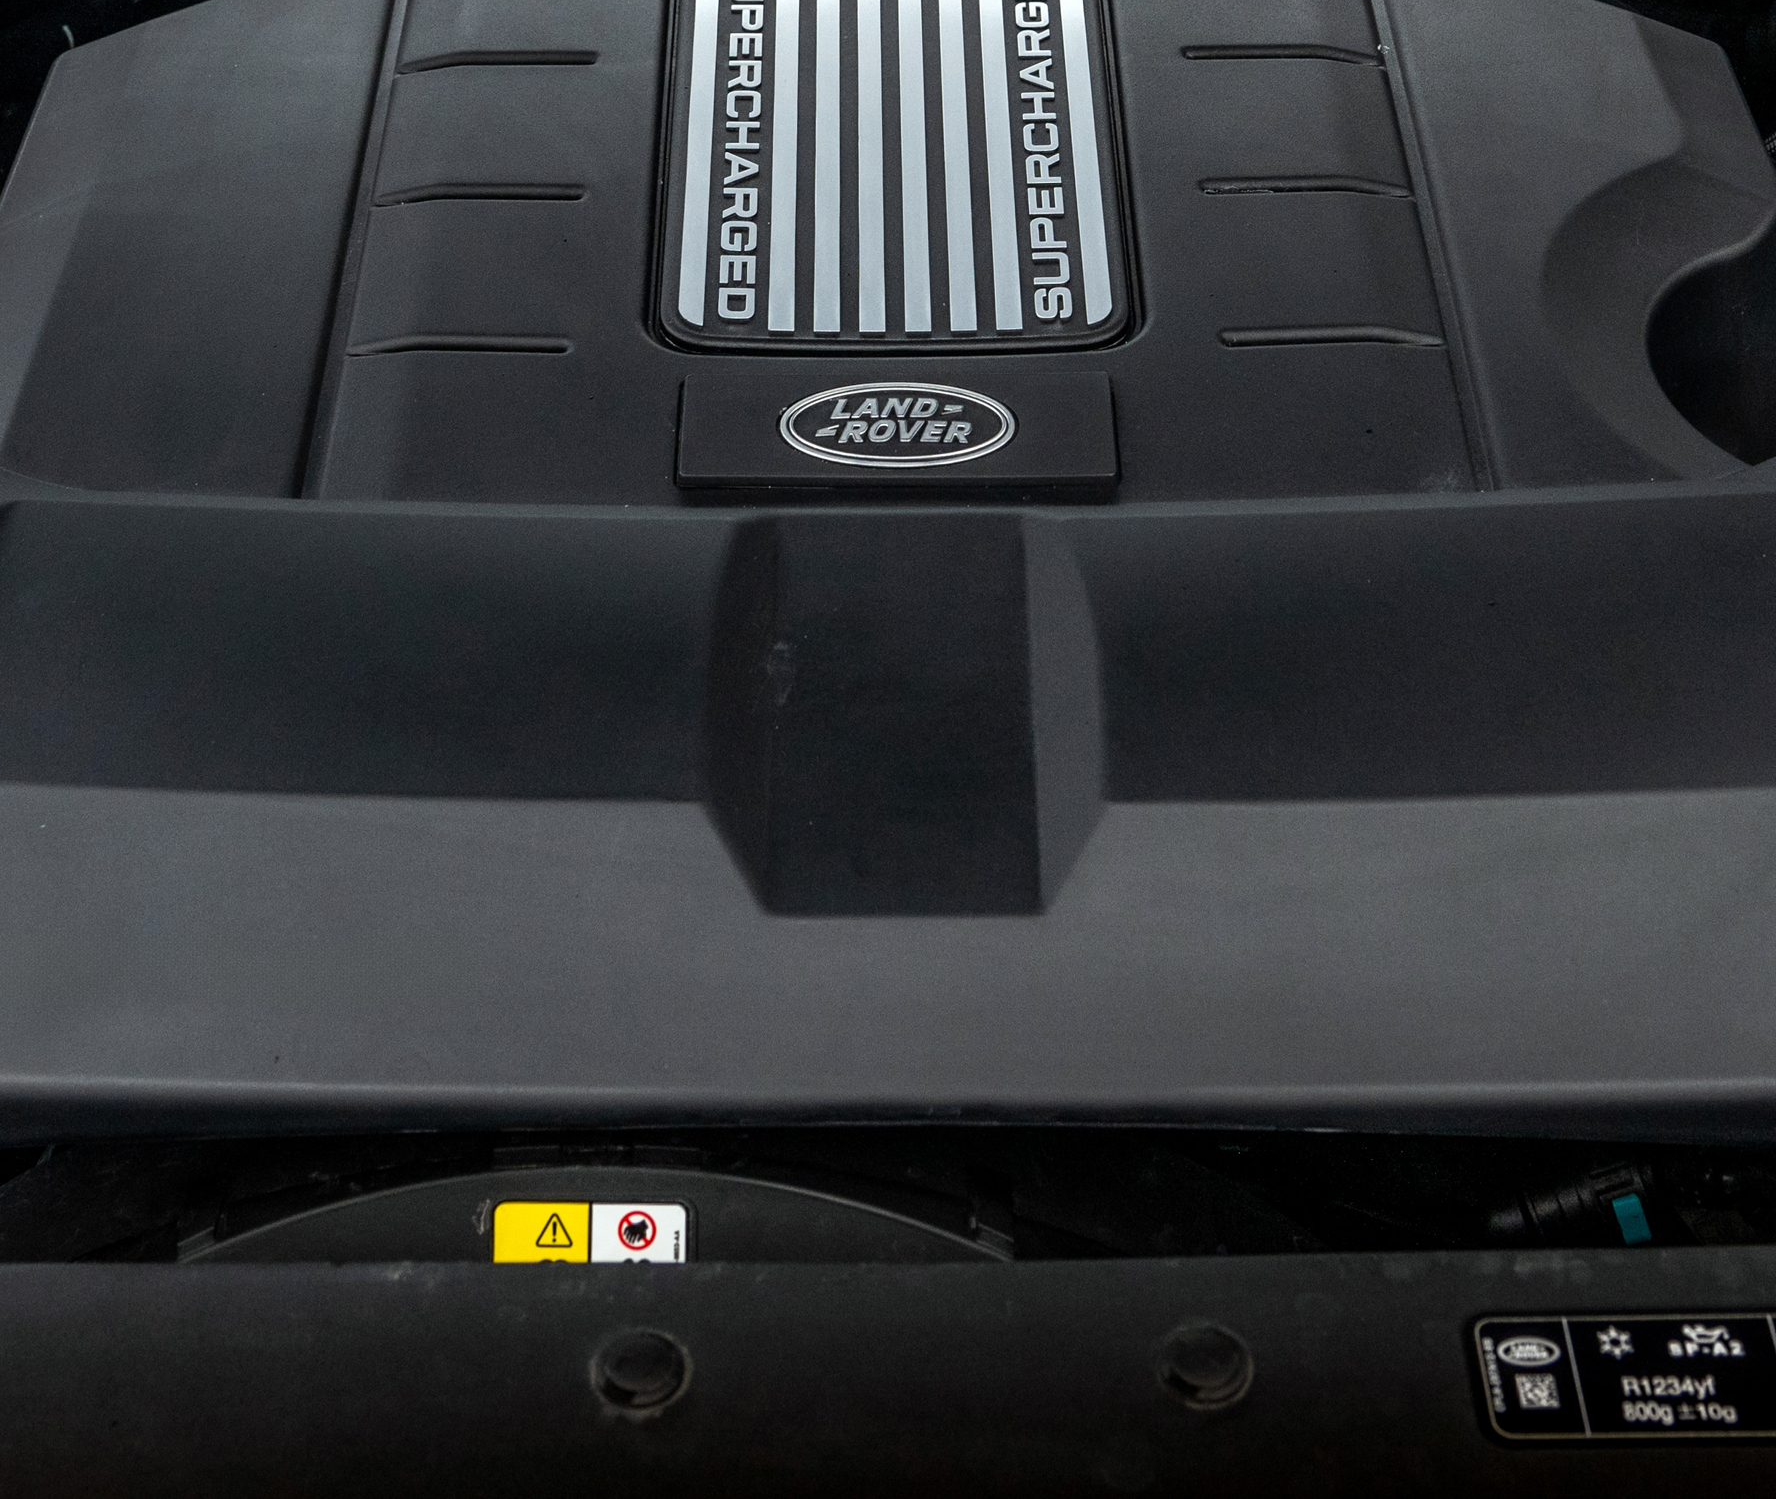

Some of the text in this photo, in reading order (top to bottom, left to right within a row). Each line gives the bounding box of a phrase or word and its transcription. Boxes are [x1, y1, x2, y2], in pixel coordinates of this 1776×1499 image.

[830, 397, 940, 419] LAND
[837, 420, 973, 444] ROVER
[1621, 1374, 1716, 1401] R1234yf
[1622, 1400, 1675, 1427] 800g
